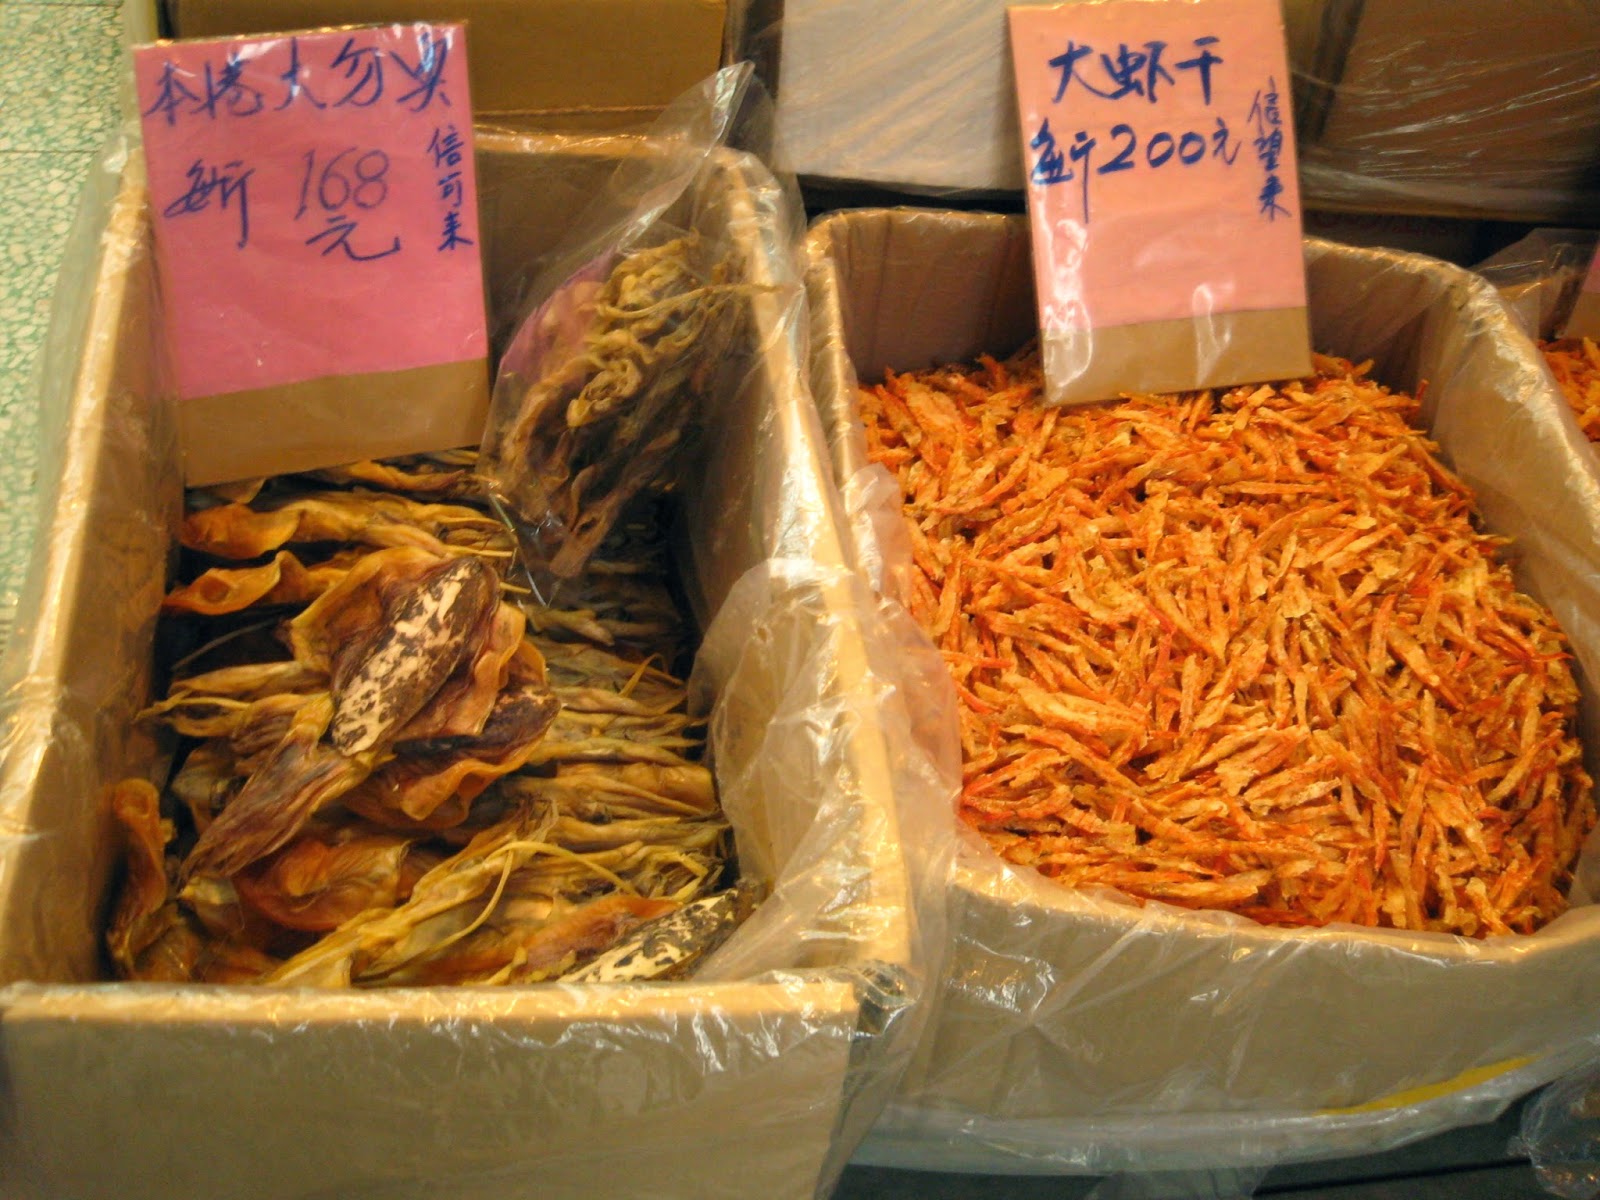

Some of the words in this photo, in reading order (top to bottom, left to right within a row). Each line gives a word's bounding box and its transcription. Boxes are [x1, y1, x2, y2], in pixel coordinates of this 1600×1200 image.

[1048, 36, 1224, 105] 大虾干
[293, 147, 390, 221] 168
[305, 215, 401, 262] 元
